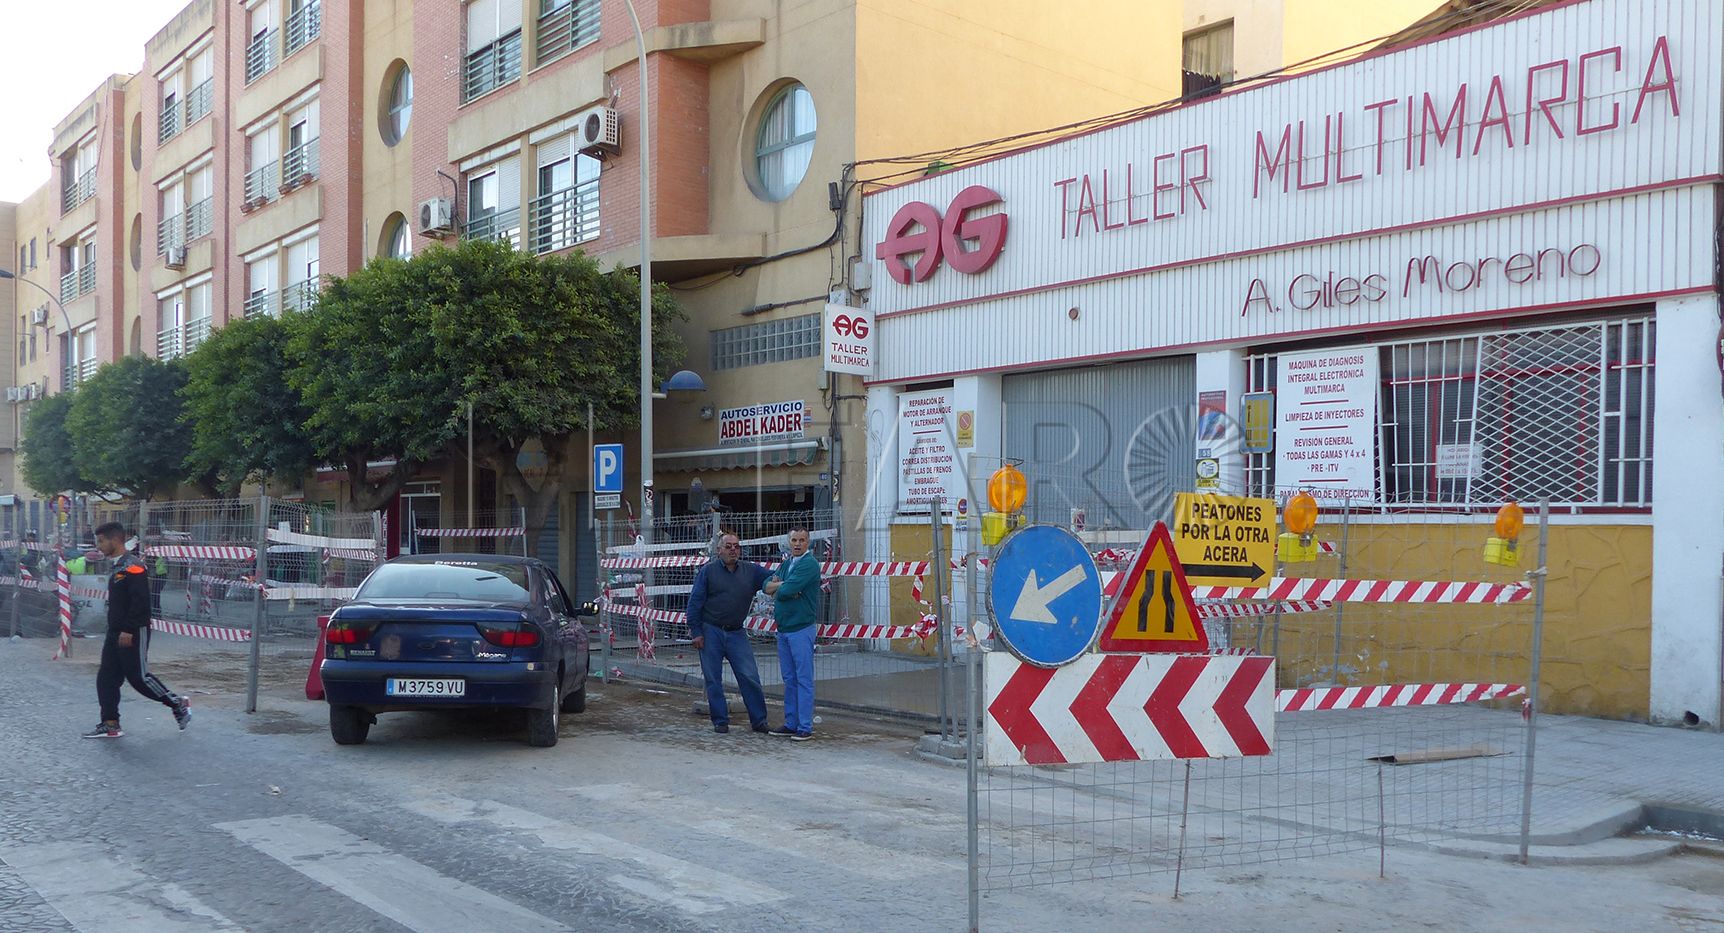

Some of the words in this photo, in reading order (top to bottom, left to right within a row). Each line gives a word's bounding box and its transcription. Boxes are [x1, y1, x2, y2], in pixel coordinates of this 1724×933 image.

[1054, 144, 1209, 239] TALLER
[1253, 35, 1680, 198] MULTIMARCA
[876, 185, 1008, 285] AG
[1241, 278, 1281, 317] A.
[1289, 271, 1386, 311] Giles
[1403, 243, 1601, 298] Moreno
[833, 314, 869, 339] AG
[831, 342, 868, 356] TALLER
[830, 354, 870, 368] MULTIMARCA
[1318, 358, 1327, 367] DE
[1328, 355, 1364, 366] DIAGNOSIS
[1287, 372, 1317, 383] INTEGRAL
[1304, 383, 1345, 395] MULTIMARCA
[938, 396, 945, 404] DE
[720, 402, 803, 420] AUTOSERVICIO
[903, 409, 919, 418] MOTOR
[919, 408, 926, 416] DE
[926, 405, 952, 415] ARRANQUE
[1285, 411, 1313, 422] LIMPIEZA
[1314, 411, 1323, 420] DE
[1324, 408, 1365, 419] INYECTORES
[914, 417, 945, 427] ALTERNADOR
[1323, 435, 1354, 446] GENERAL
[909, 446, 925, 455] ACEITE
[930, 445, 945, 453] FILTRO
[1307, 450, 1319, 460] LAS
[1320, 449, 1343, 459] GAMAS
[1343, 449, 1349, 458] Y
[1350, 449, 1355, 458] 4
[1361, 448, 1366, 457] 4
[902, 457, 919, 465] CORREA
[599, 450, 617, 487] P
[903, 467, 925, 475] PASTILLAS
[926, 466, 933, 474] DE
[933, 465, 952, 473] FRENOS
[914, 476, 939, 485] EMBRAGUE
[908, 487, 921, 495] TUBO
[1323, 489, 1332, 498] DE
[1192, 502, 1262, 522] PEATONES
[1181, 522, 1210, 540] POR
[1214, 525, 1231, 541] LA
[1235, 526, 1269, 543] OTRA
[1203, 545, 1248, 563] ACERA
[447, 681, 463, 694] VU
